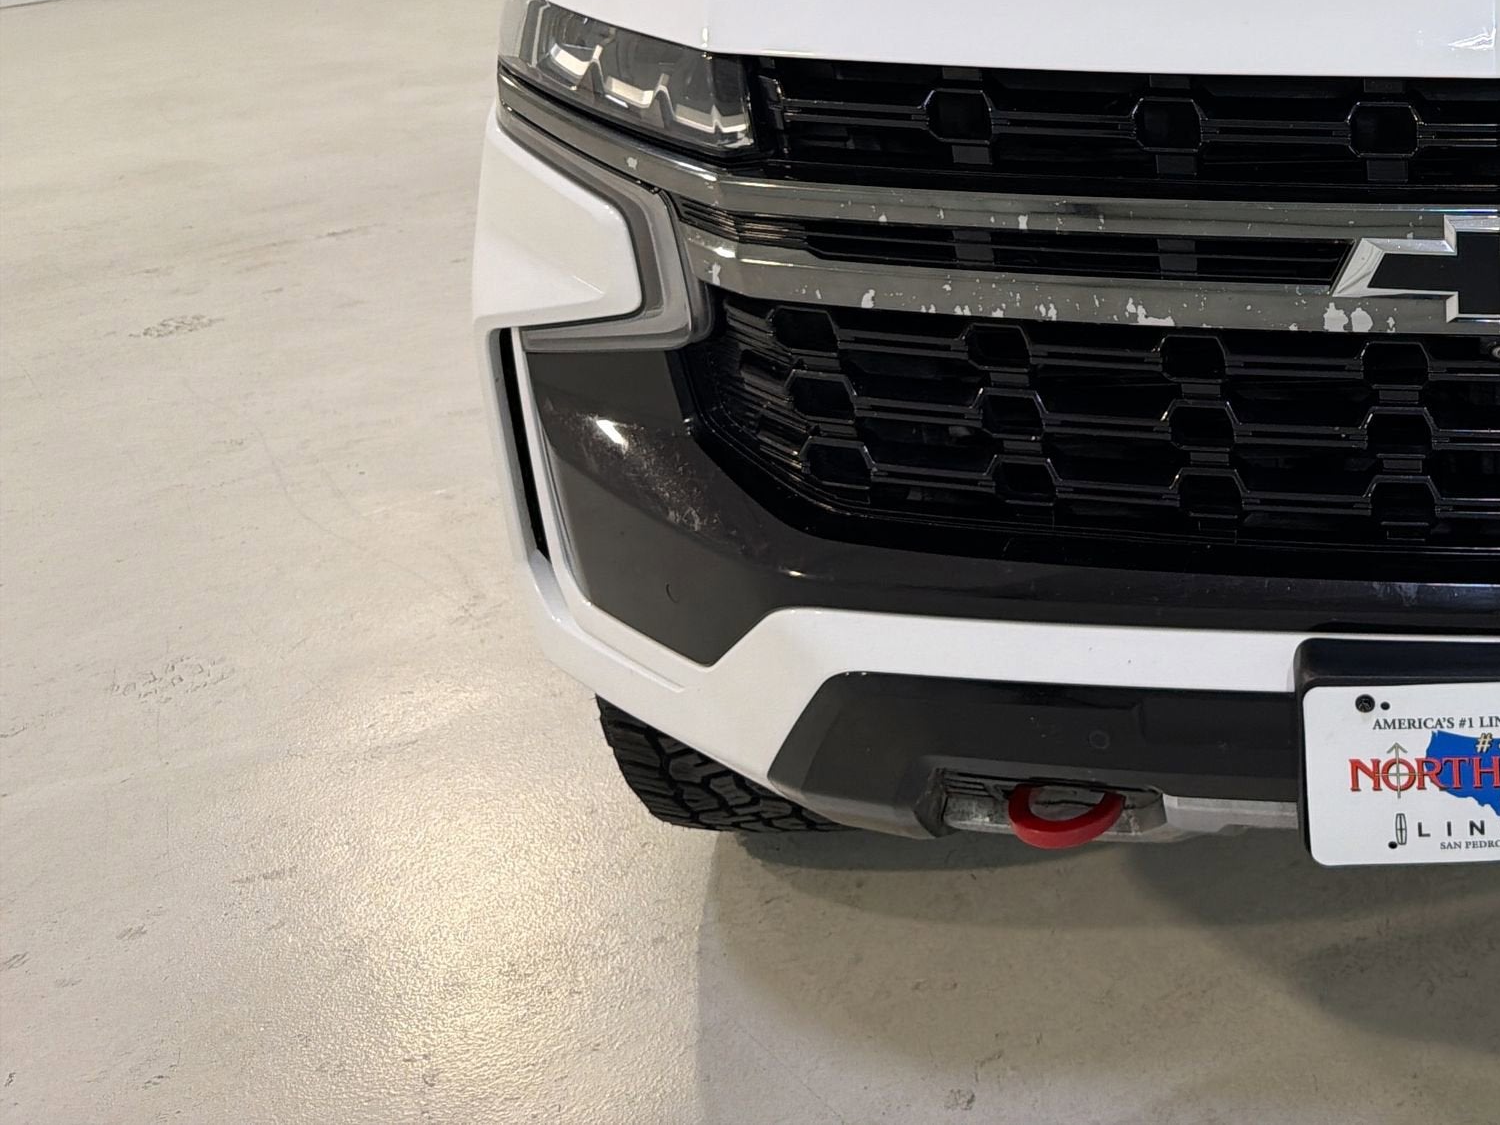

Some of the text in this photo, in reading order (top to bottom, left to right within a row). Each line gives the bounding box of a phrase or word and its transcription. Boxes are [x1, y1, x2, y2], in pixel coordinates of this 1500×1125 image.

[1372, 716, 1454, 730] AMERICA'S
[1458, 716, 1474, 729] #1
[1440, 840, 1462, 850] SAN
